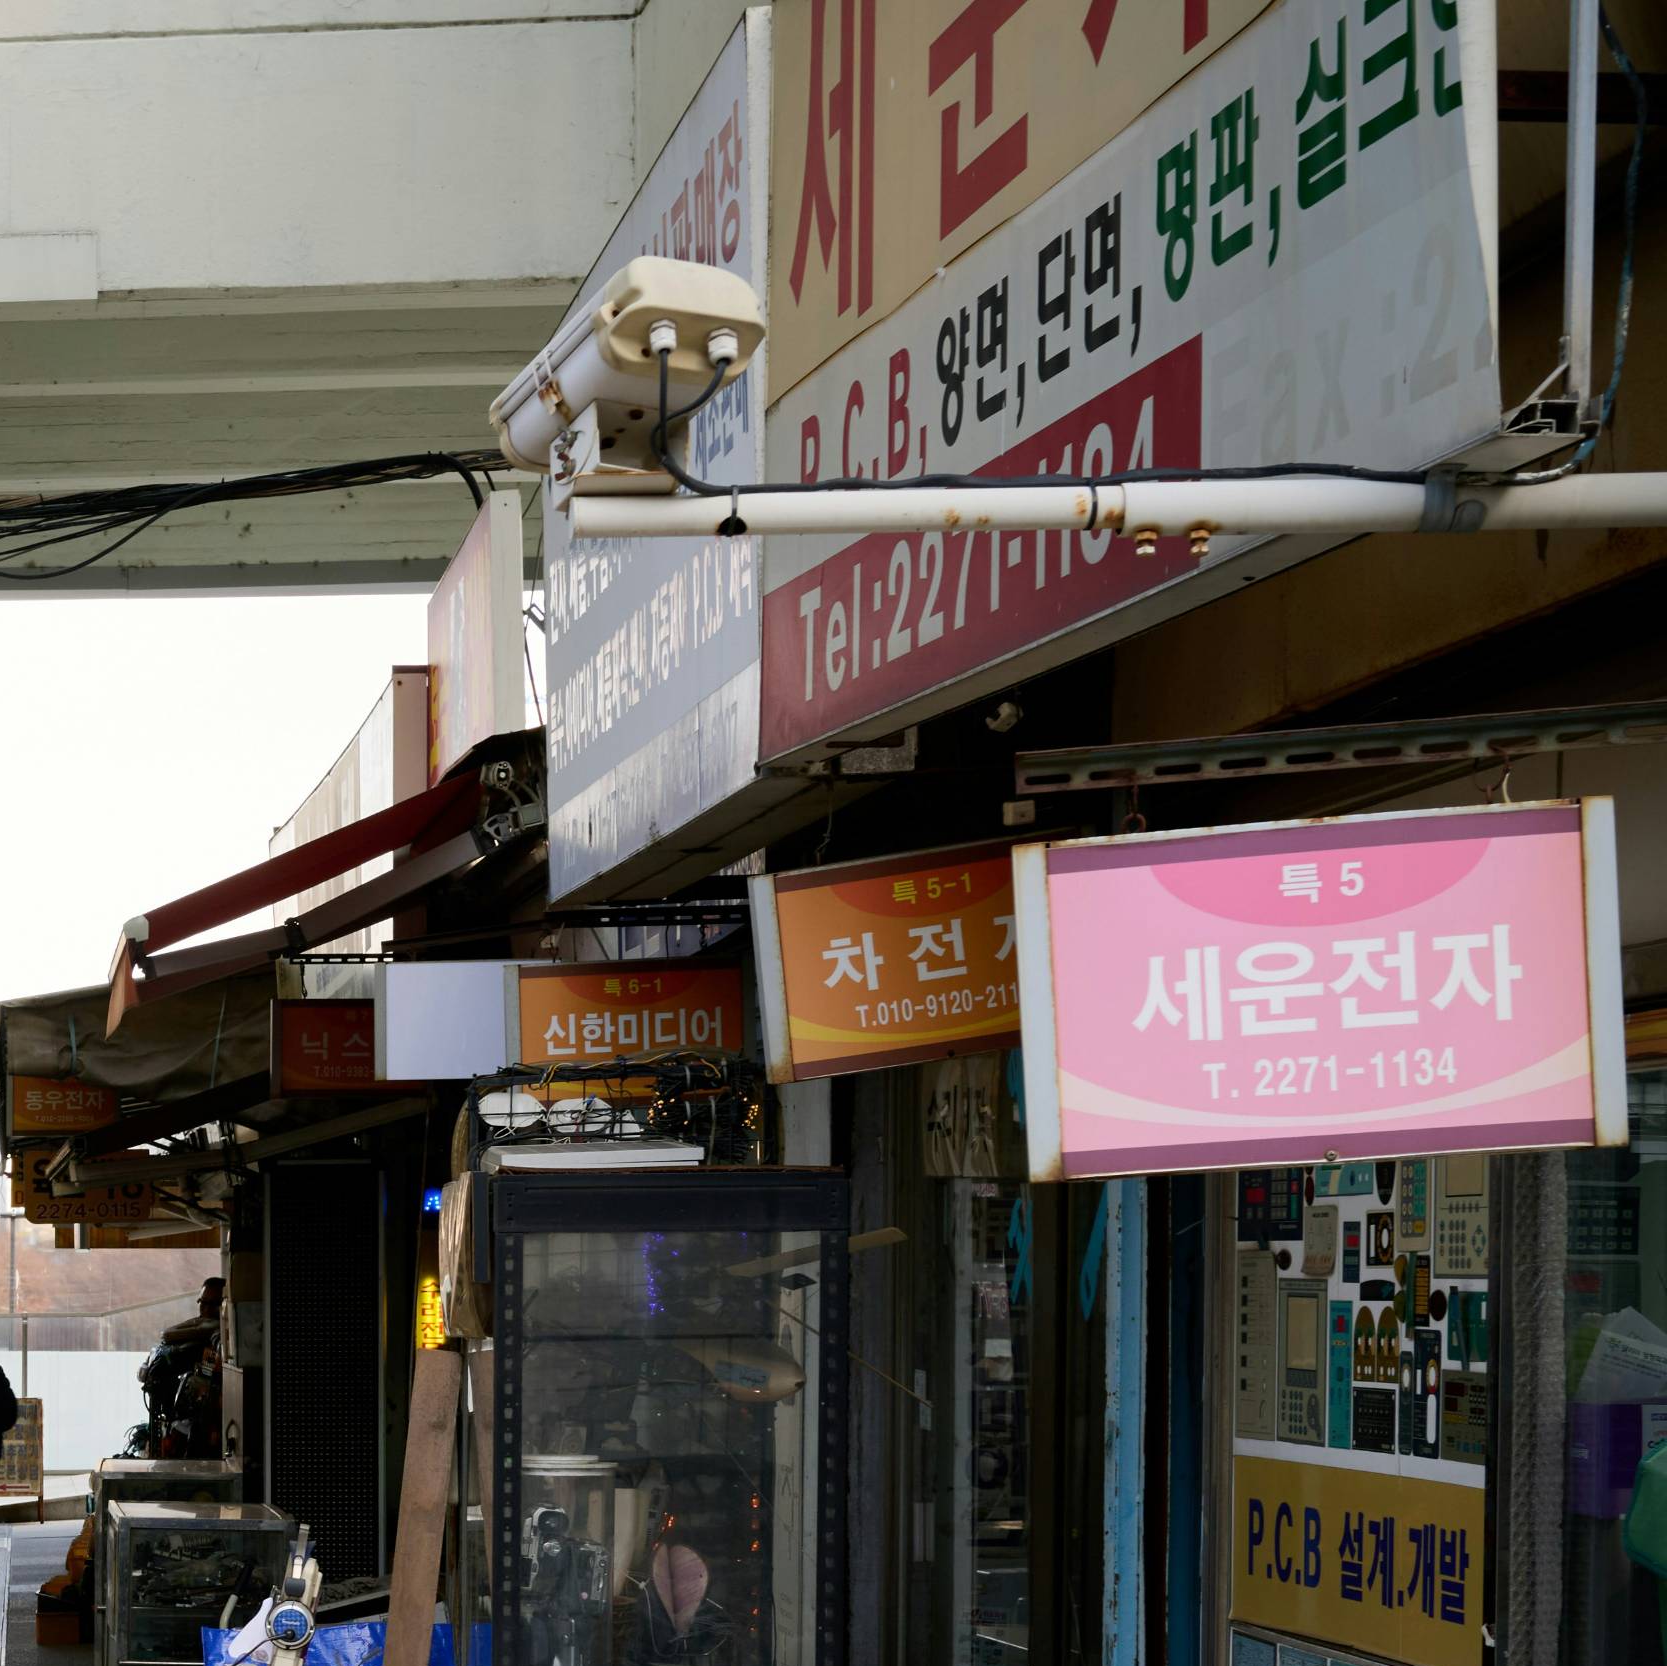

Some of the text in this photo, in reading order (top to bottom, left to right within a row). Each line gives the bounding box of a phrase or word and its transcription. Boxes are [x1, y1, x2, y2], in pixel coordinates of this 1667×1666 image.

[892, 872, 972, 905] 특 5-1
[1278, 860, 1366, 905] 특 5
[603, 978, 662, 997] 특 6-1
[1133, 922, 1524, 1046] 세운전자
[543, 1006, 722, 1056] 신한미디어
[1252, 1046, 1459, 1098] 2271-1134
[26, 1090, 106, 1111] 동우전자
[36, 1202, 141, 1220] 2274-0115
[1248, 1498, 1322, 1588] P.C.B
